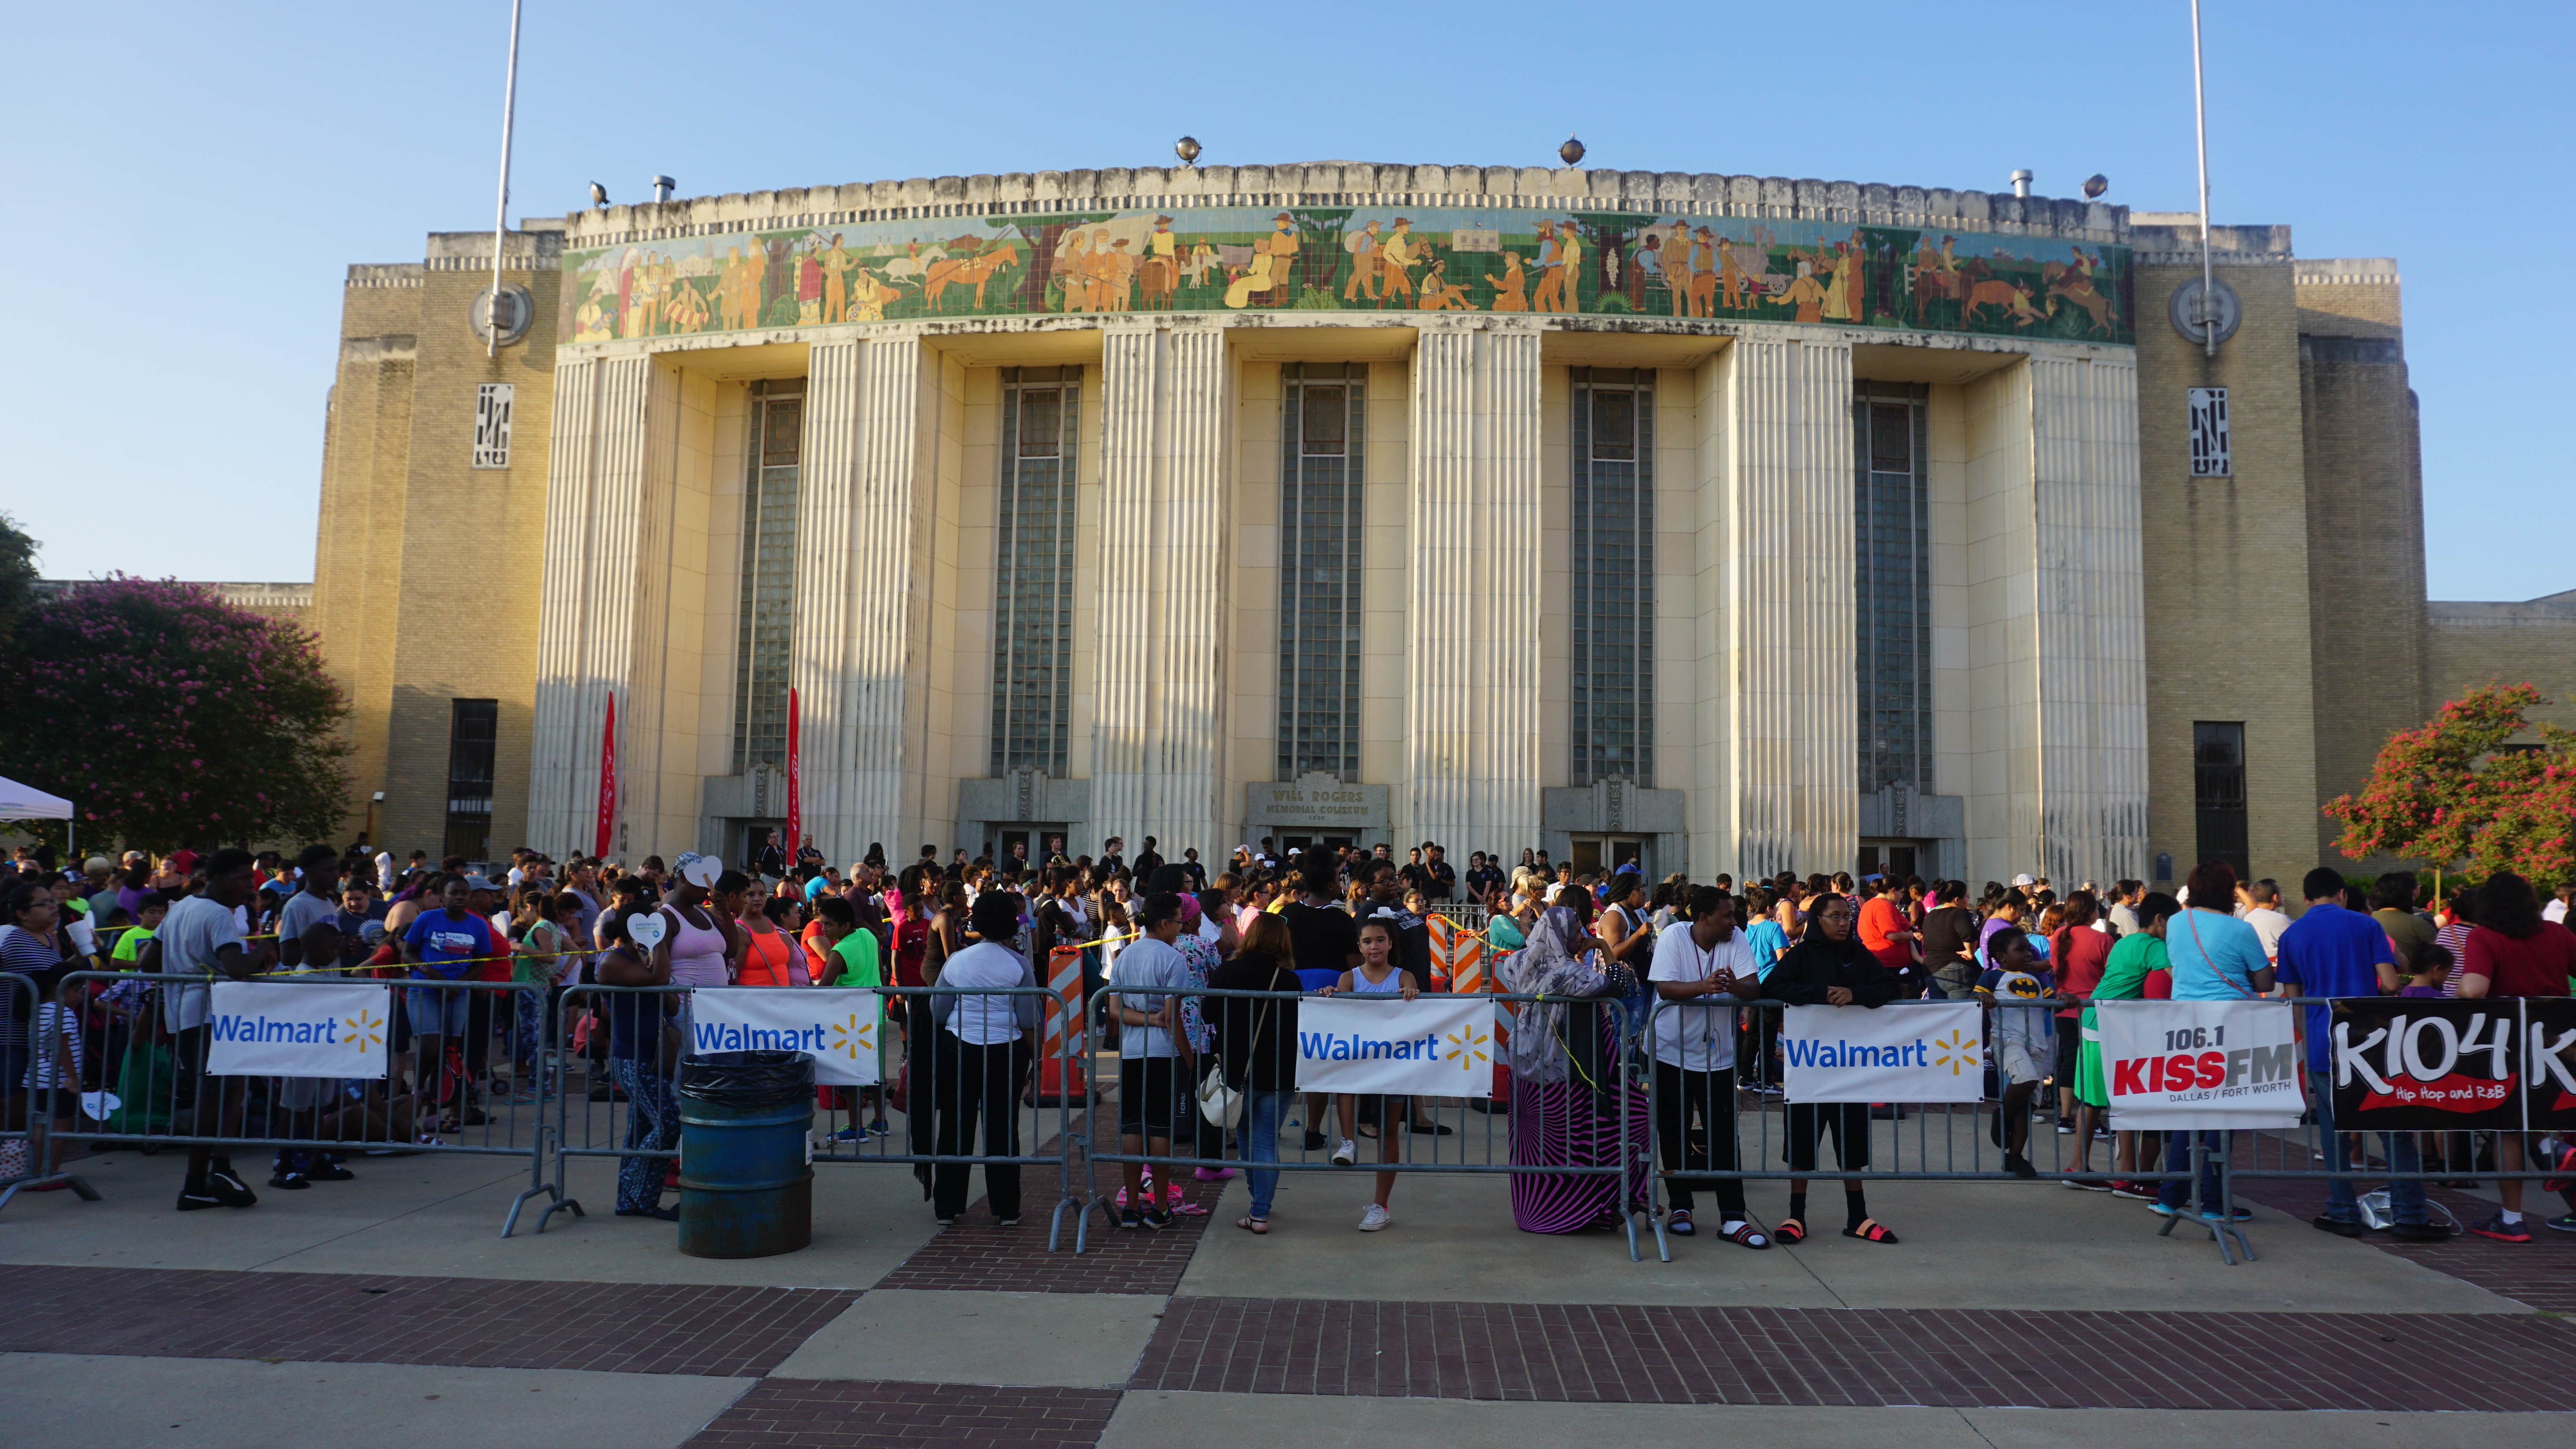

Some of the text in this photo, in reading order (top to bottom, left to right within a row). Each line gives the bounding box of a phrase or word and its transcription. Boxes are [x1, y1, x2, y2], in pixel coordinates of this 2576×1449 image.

[1272, 790, 1364, 802] WILL ROGERS
[1267, 805, 1369, 815] MEMORIAL COLISEUM
[212, 1015, 337, 1044] Walmart
[695, 1023, 825, 1050] Walmart
[2165, 1025, 2224, 1051] 106.1
[1300, 1032, 1439, 1061] Walmart
[1786, 1039, 1927, 1068] Walmart
[2334, 1013, 2511, 1096] K104
[2169, 1081, 2291, 1102] DALLAS / FORT WORTH
[2396, 1085, 2506, 1102] Hip Hop and R&B
